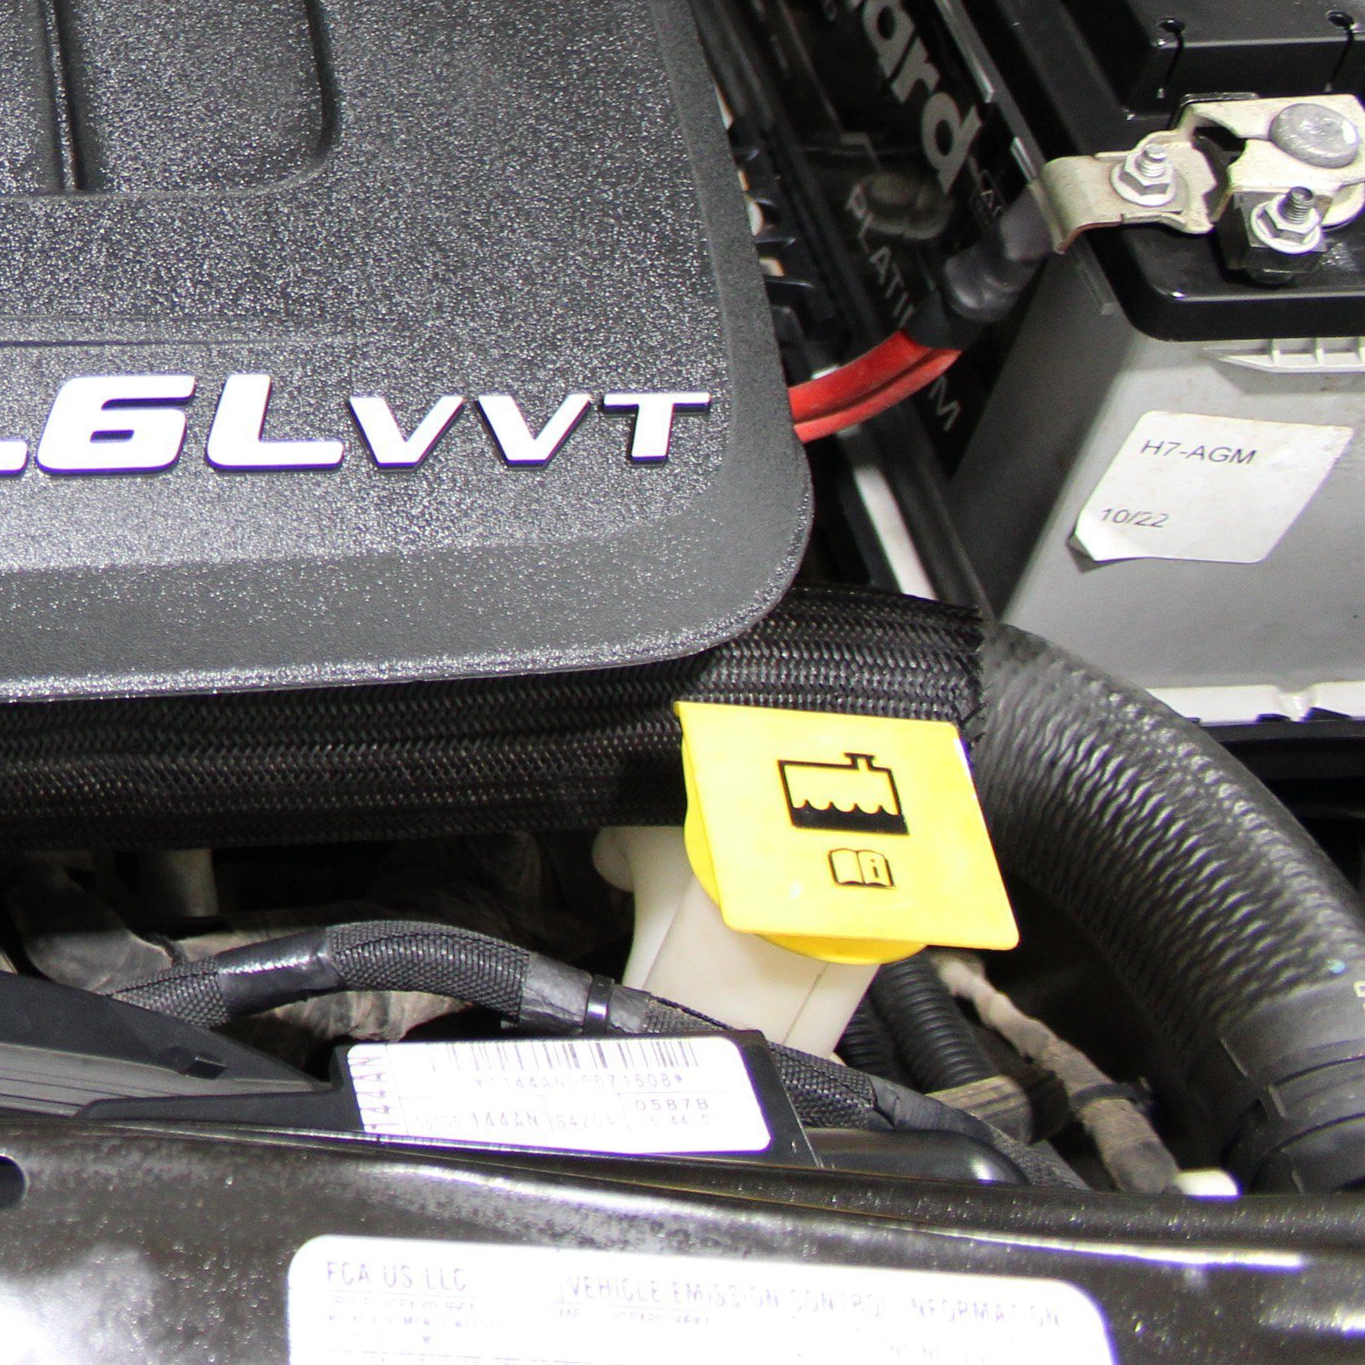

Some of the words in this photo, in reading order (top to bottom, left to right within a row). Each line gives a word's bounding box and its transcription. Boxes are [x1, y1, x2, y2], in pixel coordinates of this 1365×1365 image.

[350, 392, 712, 471] VVT
[1139, 439, 1258, 465] H7-AGM
[1100, 505, 1169, 530] 10/22
[326, 1261, 370, 1283] FCA
[383, 1264, 414, 1289] US
[425, 1267, 467, 1293] LLC
[570, 1275, 661, 1303] VEHICLE
[672, 1280, 779, 1309] EMISSION
